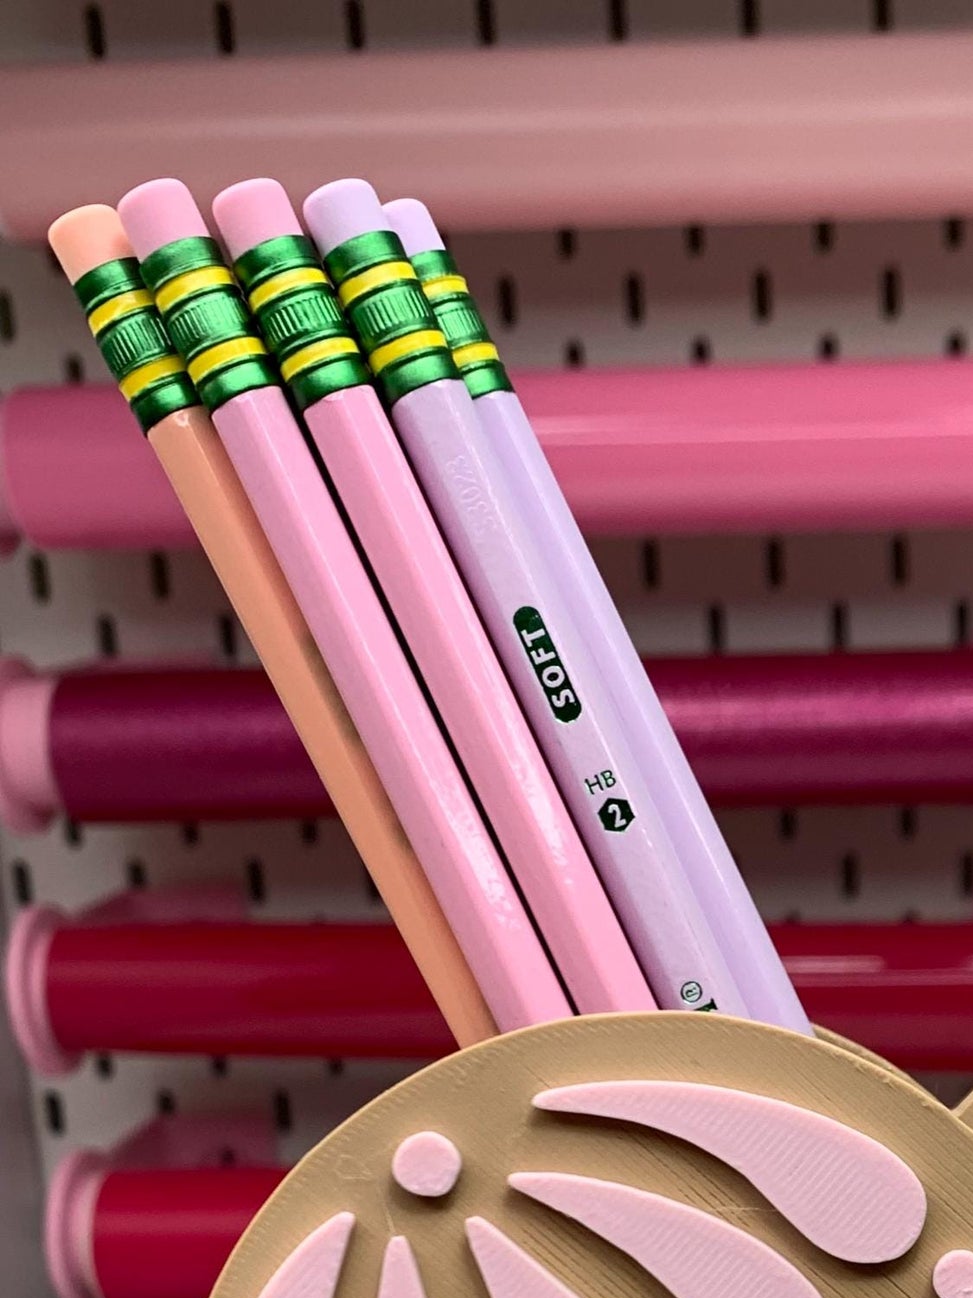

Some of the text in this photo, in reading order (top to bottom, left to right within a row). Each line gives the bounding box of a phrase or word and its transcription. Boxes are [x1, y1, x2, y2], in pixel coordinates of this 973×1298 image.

[520, 628, 576, 708] SOFT
[584, 769, 616, 795] HB
[607, 803, 627, 828] 2
